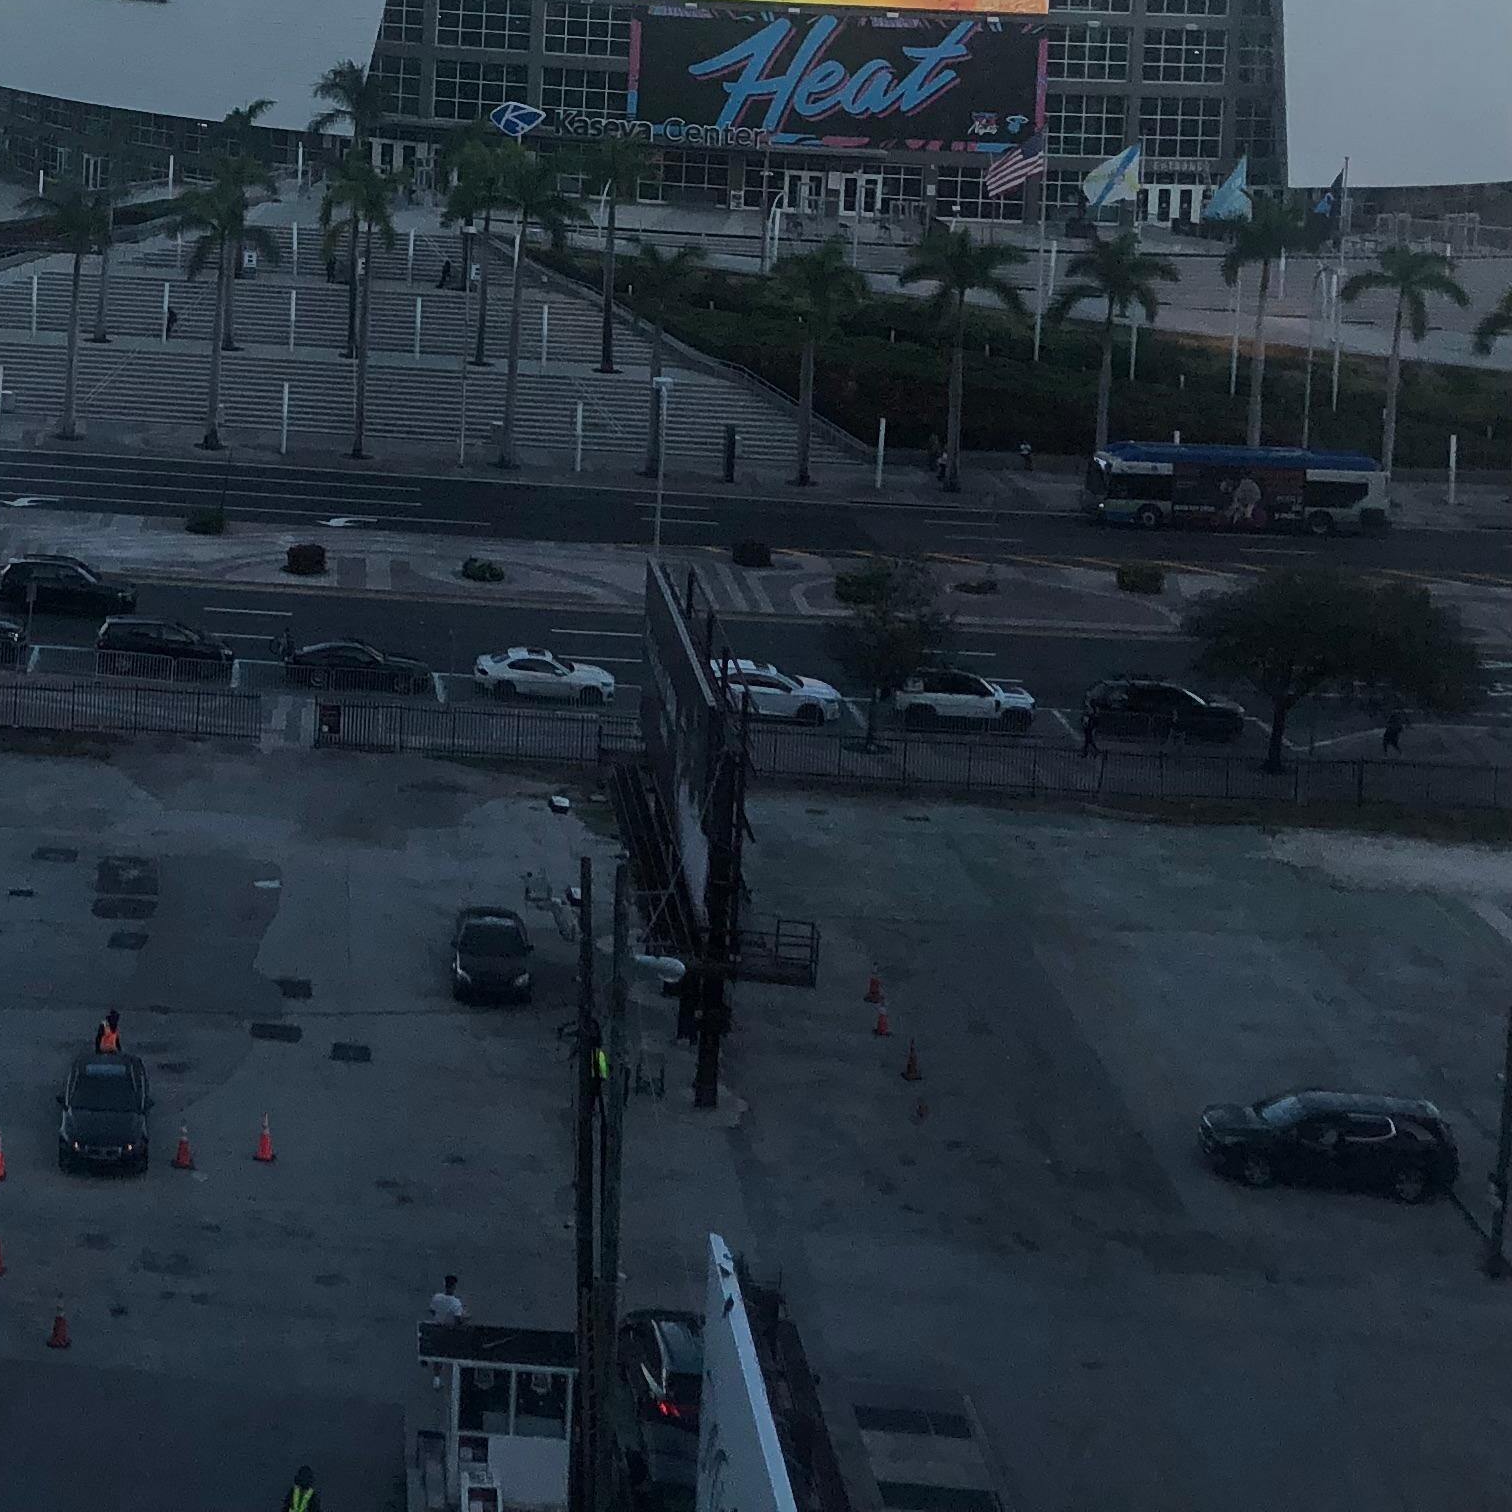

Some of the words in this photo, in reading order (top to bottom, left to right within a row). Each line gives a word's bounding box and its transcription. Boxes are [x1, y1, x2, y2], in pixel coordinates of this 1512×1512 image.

[688, 14, 978, 133] Heat
[554, 110, 653, 143] Kaseya
[663, 117, 767, 149] Center
